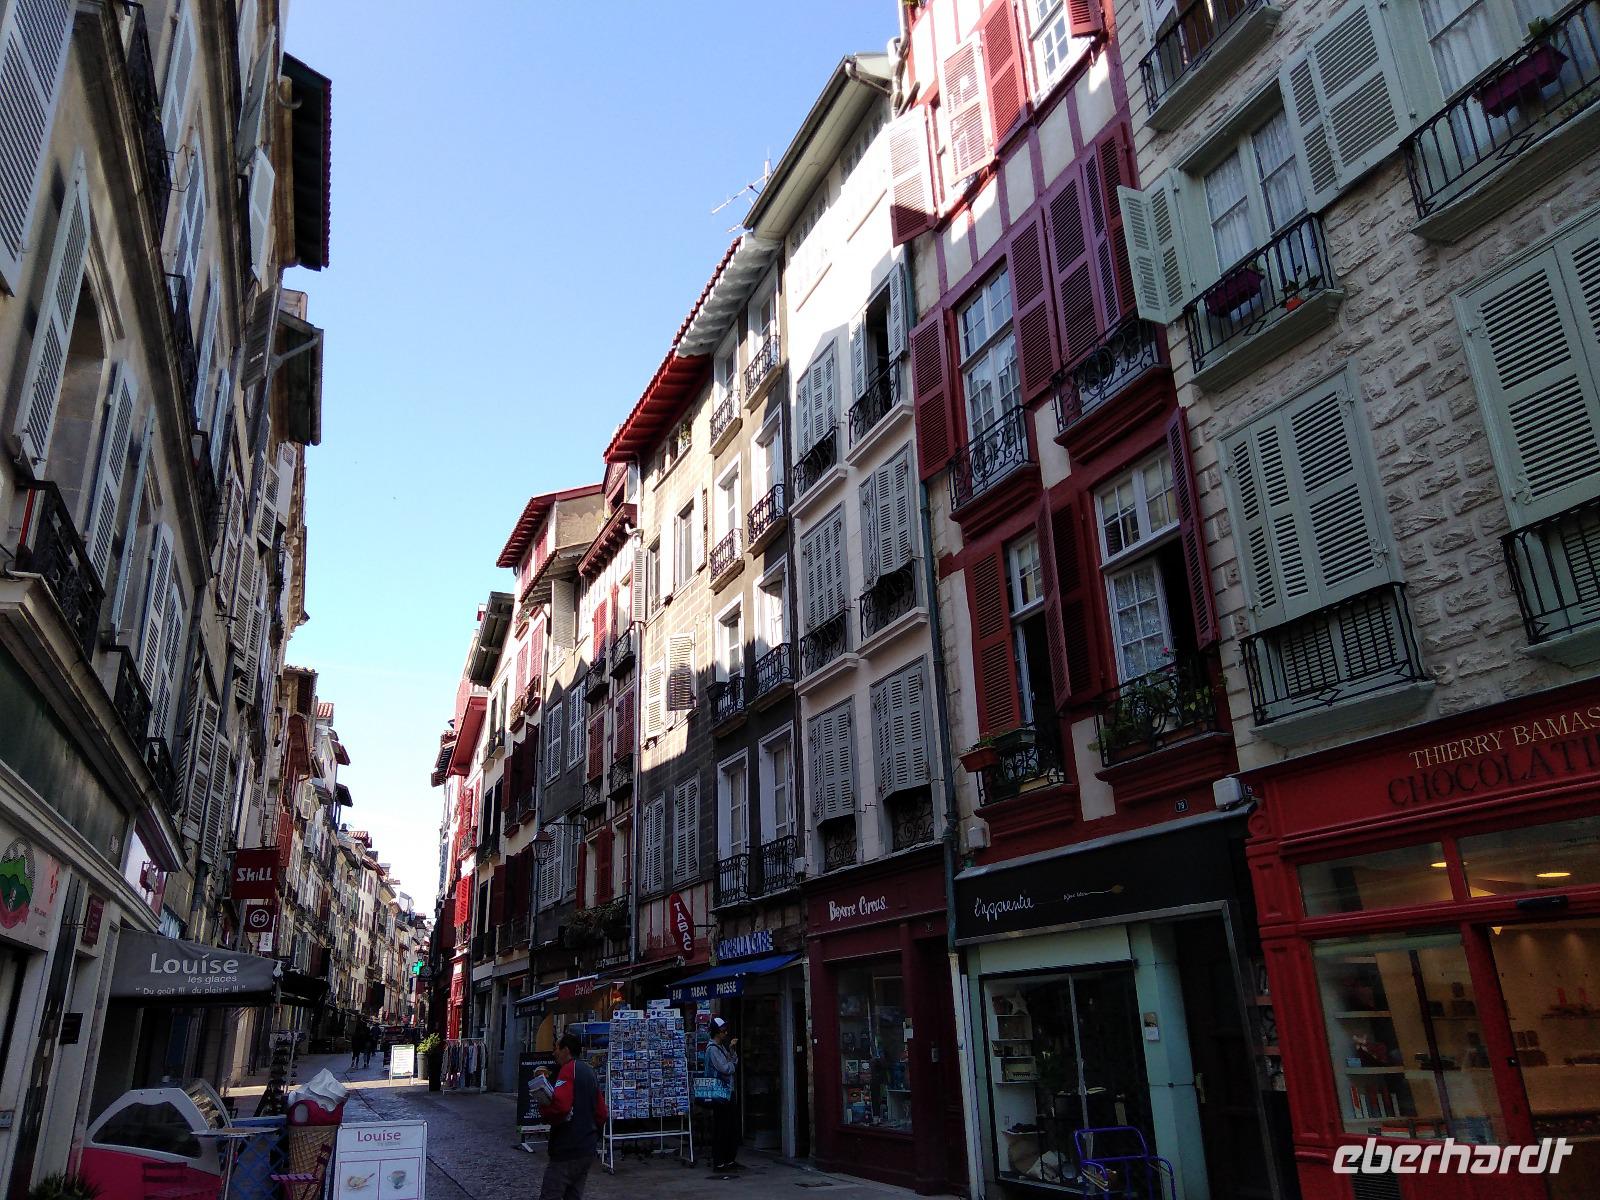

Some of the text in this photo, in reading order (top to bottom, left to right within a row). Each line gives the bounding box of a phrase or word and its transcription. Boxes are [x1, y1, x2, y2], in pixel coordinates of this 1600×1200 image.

[1409, 730, 1504, 769] THIERRY
[253, 913, 266, 923] 64
[673, 902, 692, 951] TABAC
[205, 975, 237, 985] glaces
[716, 980, 737, 995] PRESSE
